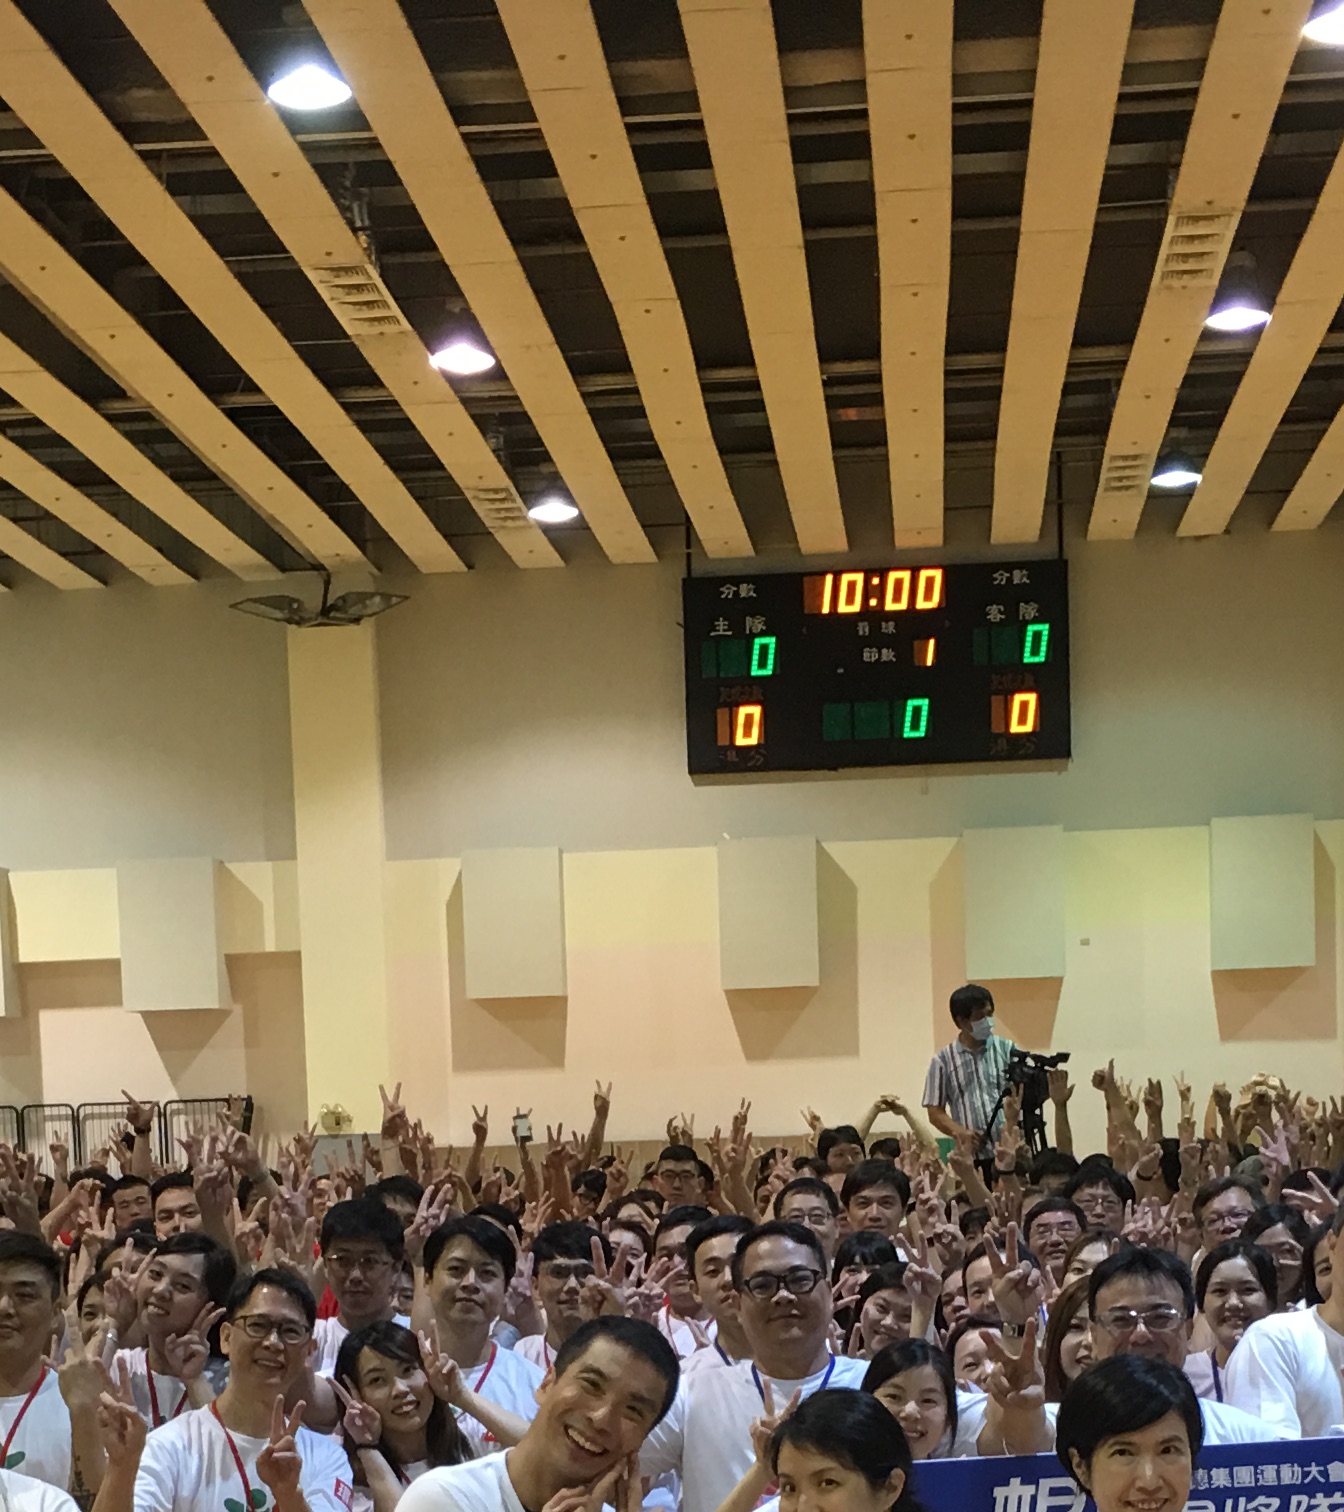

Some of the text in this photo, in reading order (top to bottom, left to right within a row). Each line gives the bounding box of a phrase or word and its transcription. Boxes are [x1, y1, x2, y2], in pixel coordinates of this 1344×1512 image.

[719, 583, 757, 599] 分數
[821, 568, 943, 614] 10:00
[991, 569, 1030, 585] 分數
[709, 615, 767, 636] 主隊
[985, 602, 1039, 622] 客隊
[750, 636, 776, 677] 0
[1023, 623, 1050, 664] 0
[735, 705, 762, 746] 0
[903, 698, 929, 738] 0
[1010, 692, 1037, 733] 0
